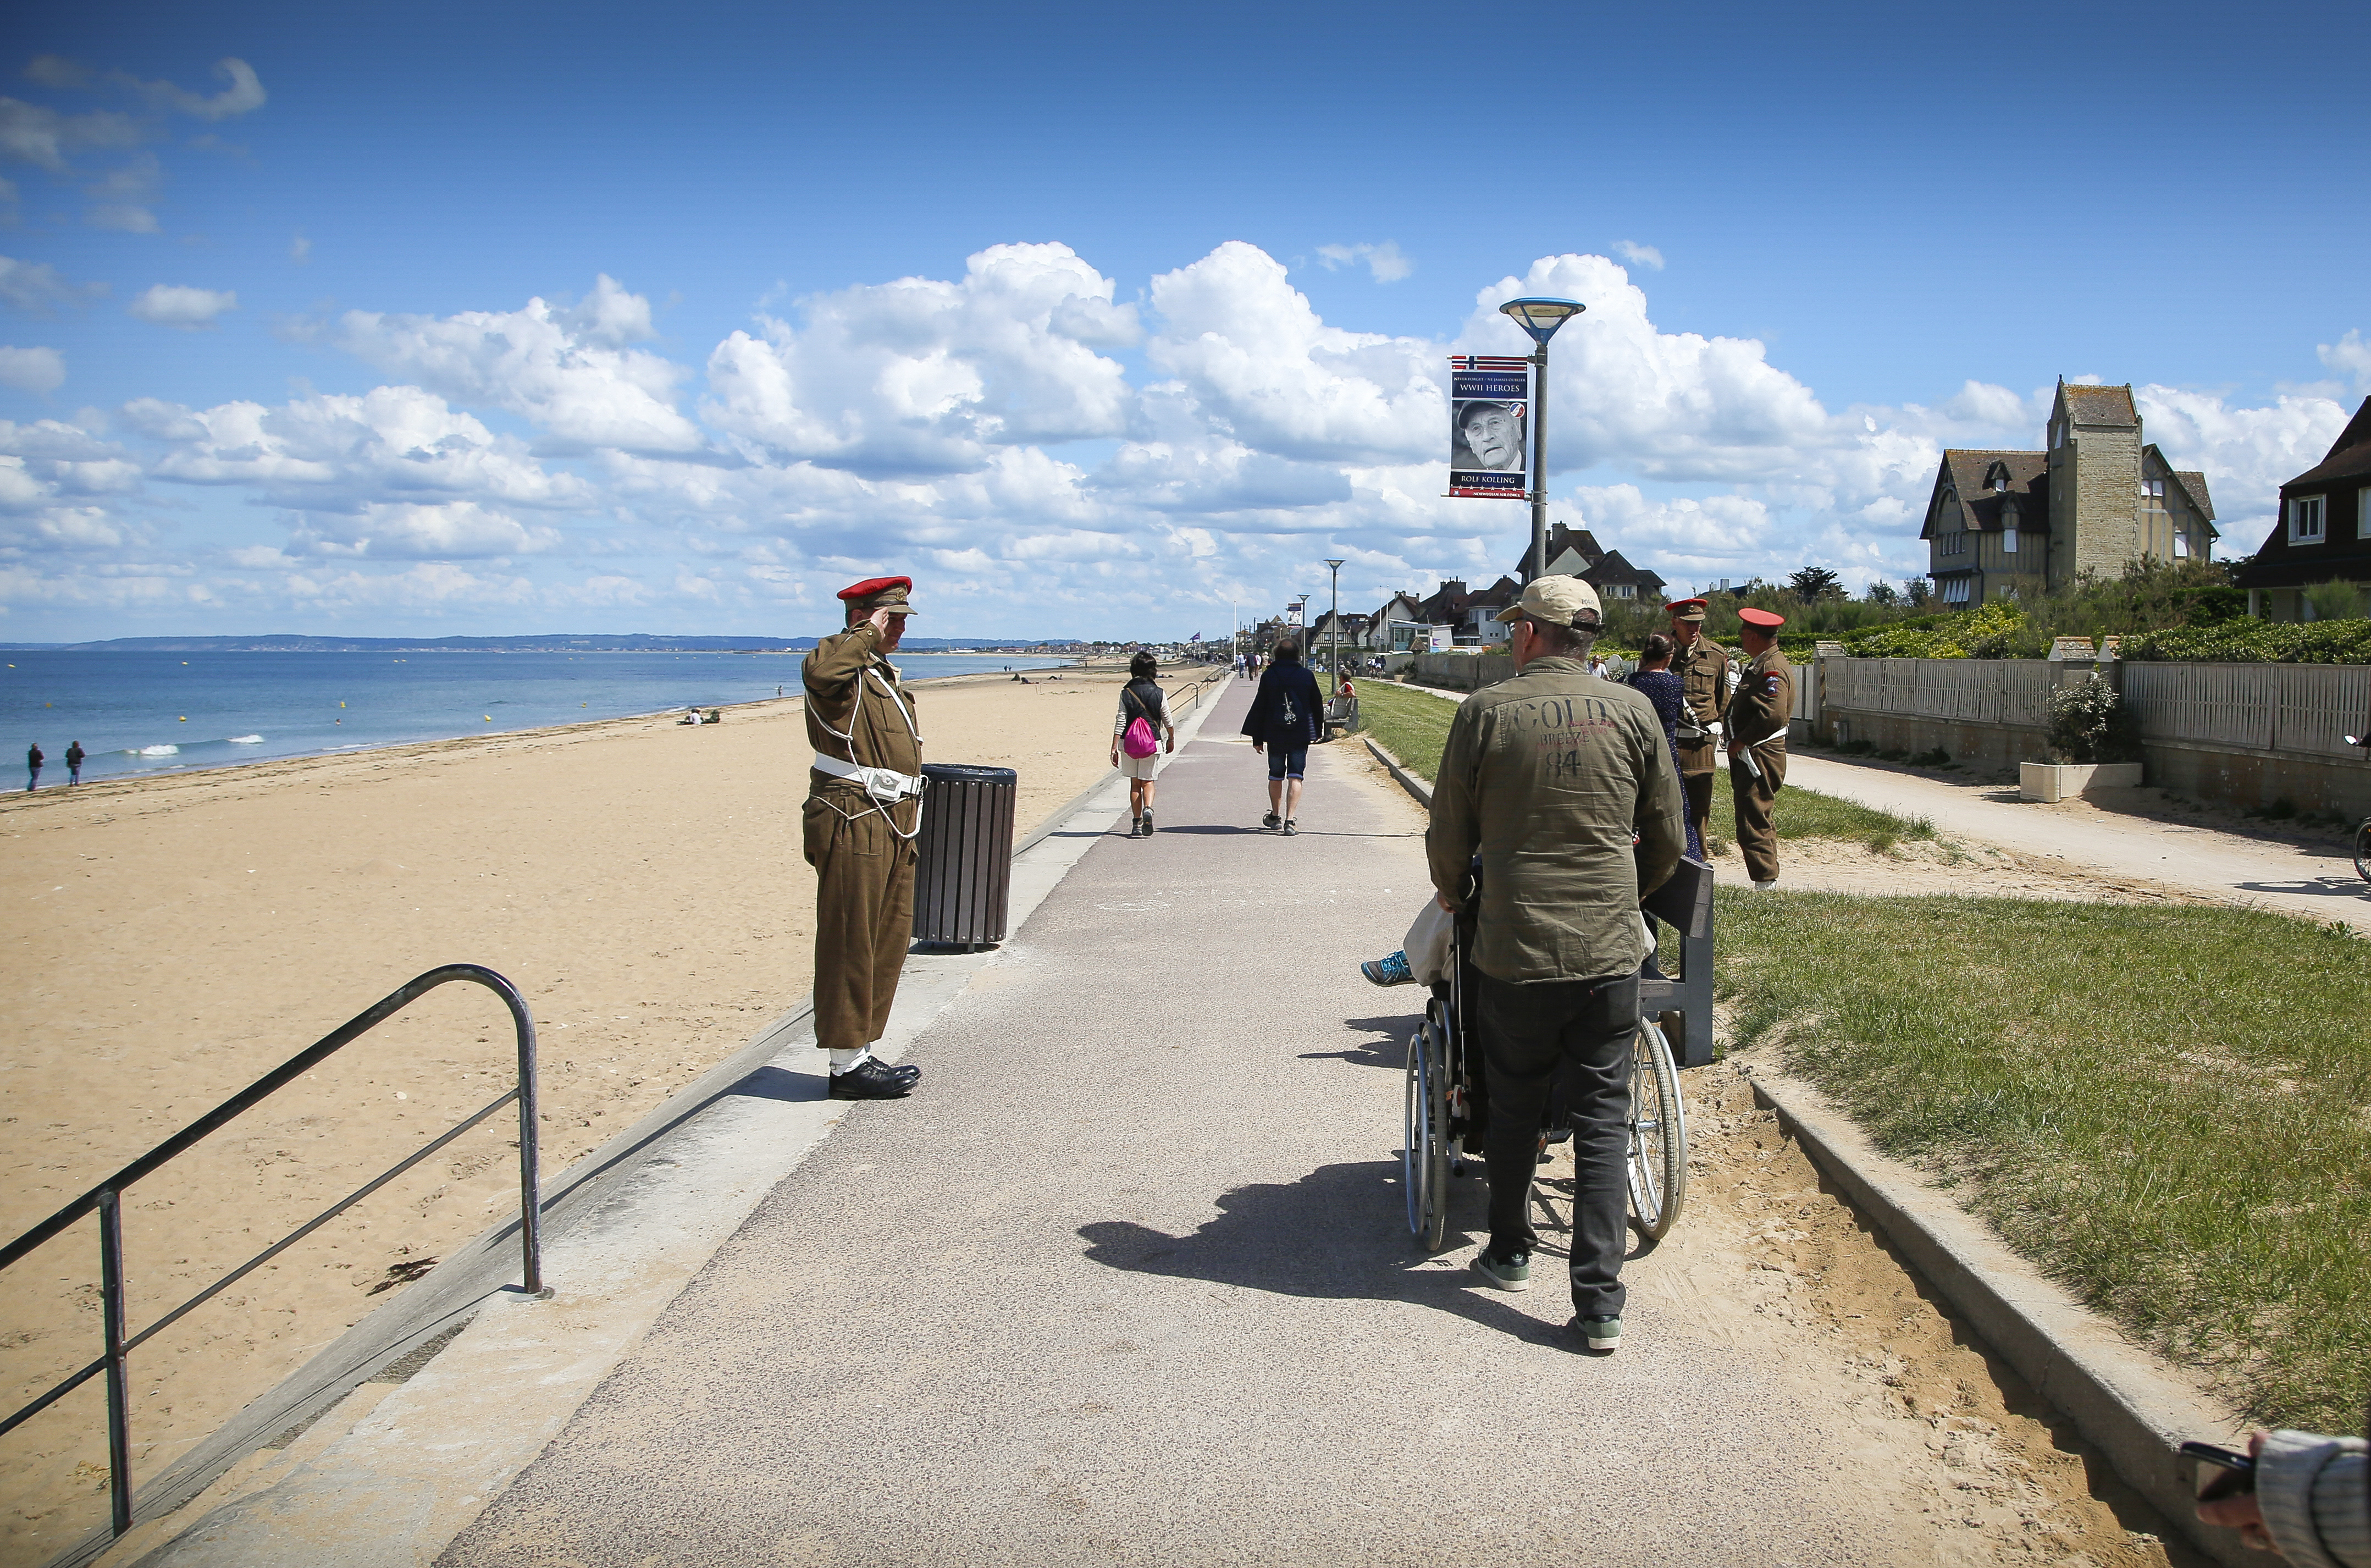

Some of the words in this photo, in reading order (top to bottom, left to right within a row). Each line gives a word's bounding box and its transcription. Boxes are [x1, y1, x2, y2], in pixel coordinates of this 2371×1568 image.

[1513, 699, 1607, 732] COLD
[1540, 731, 1590, 745] BREEZE
[1546, 750, 1582, 778] 84
